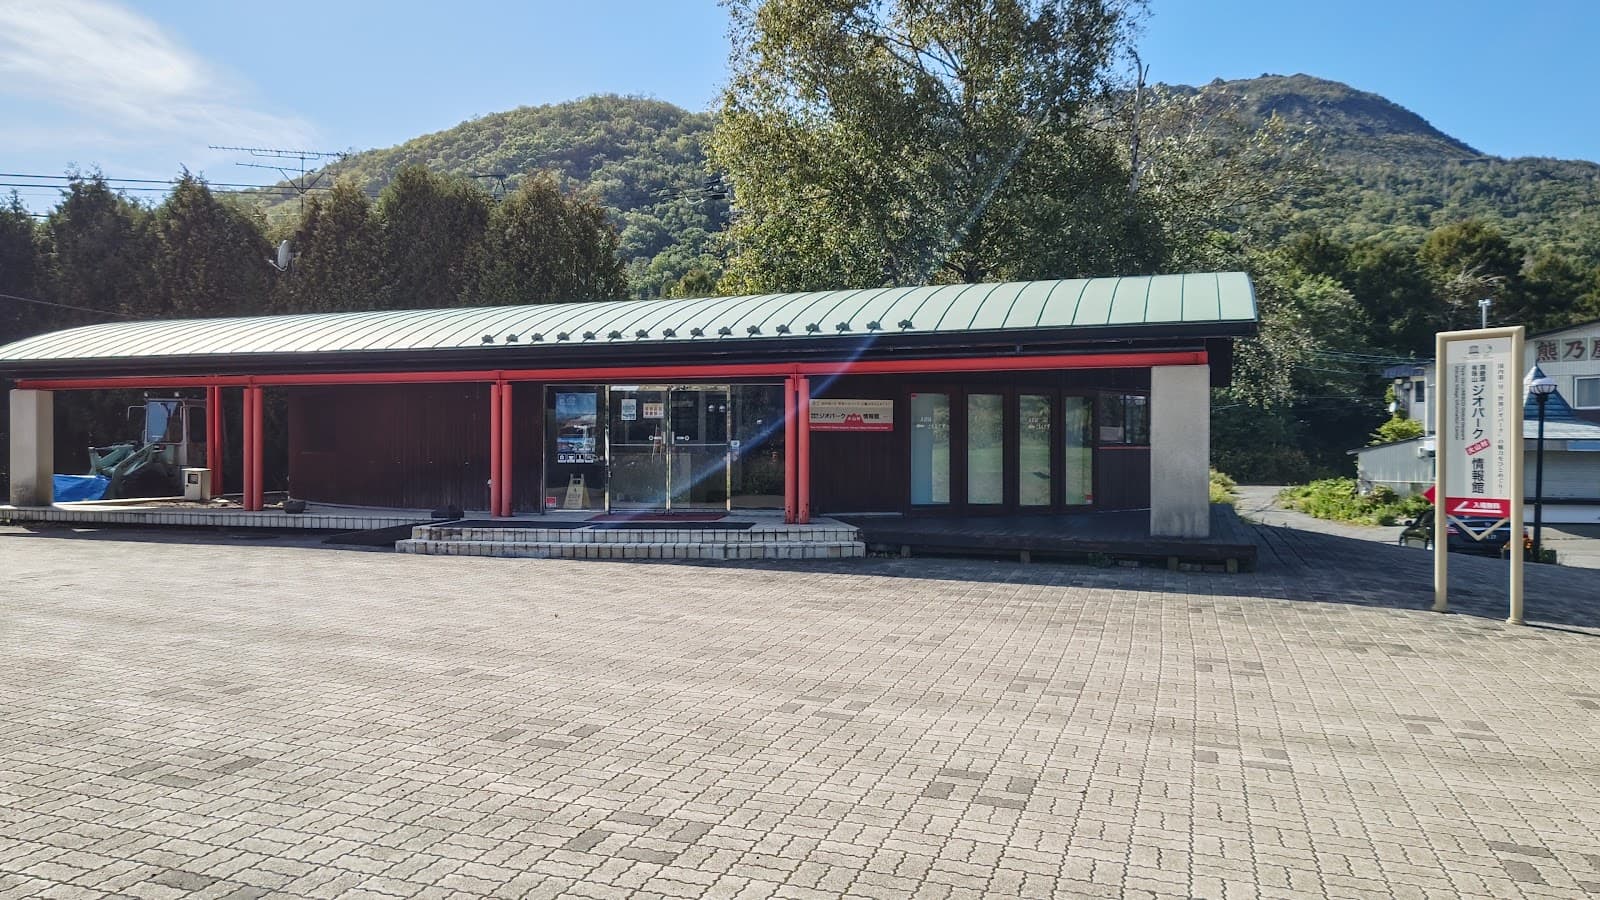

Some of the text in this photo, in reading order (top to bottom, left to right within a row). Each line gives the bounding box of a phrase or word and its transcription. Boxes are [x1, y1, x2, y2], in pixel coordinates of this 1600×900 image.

[1472, 384, 1485, 439] ジオパーク
[1472, 458, 1485, 494] 情報館
